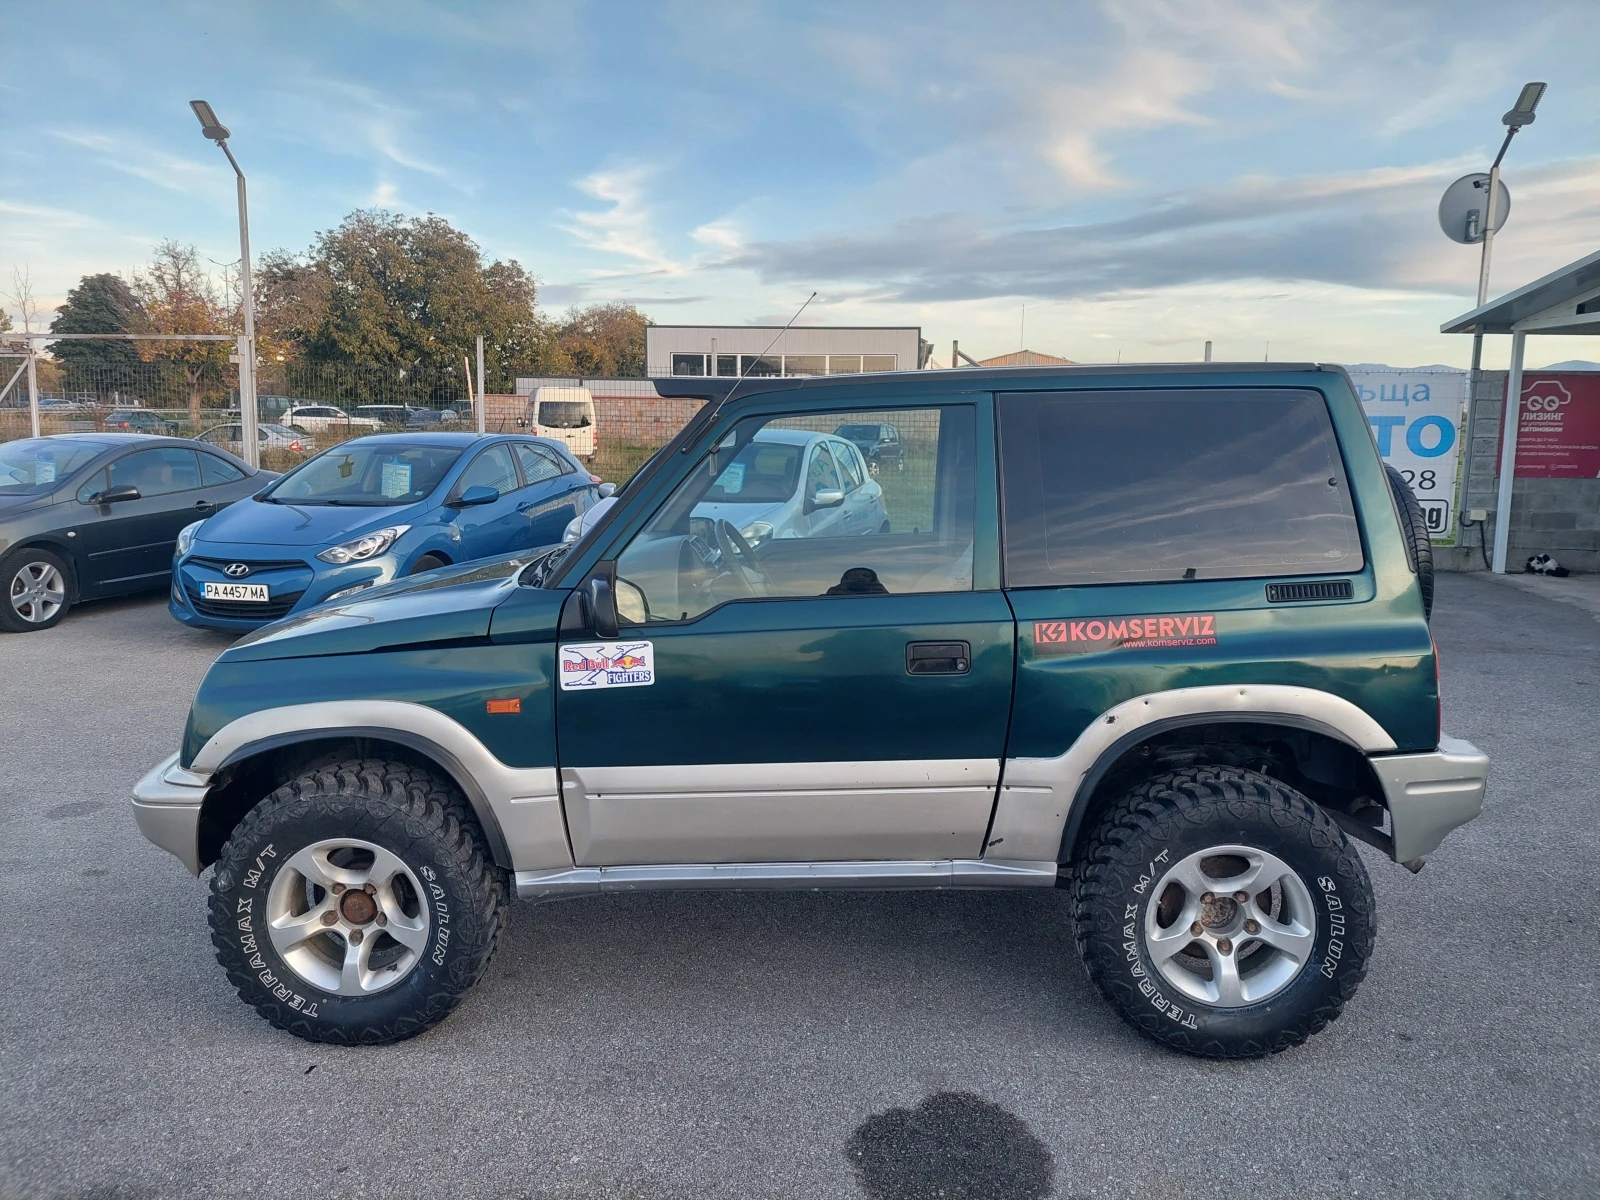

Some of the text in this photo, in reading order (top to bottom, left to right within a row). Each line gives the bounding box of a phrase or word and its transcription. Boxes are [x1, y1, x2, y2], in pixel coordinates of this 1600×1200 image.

[1355, 383, 1431, 406] ъща
[1521, 412, 1564, 421] ЛИЗИНГ
[1368, 415, 1456, 458] ТО
[206, 585, 265, 599] PA 4457 MA
[1070, 615, 1216, 641] KOMSERVIZ
[1123, 637, 1217, 648] www.komserviz.com
[564, 657, 609, 672] Red Bull
[607, 670, 651, 684] FIGHTERS
[419, 865, 451, 966] SAILUN
[1317, 875, 1346, 979] SAILUN
[236, 843, 319, 1018] TERRAMAX M/T
[1122, 848, 1198, 1030] TERRAMAX M/T
